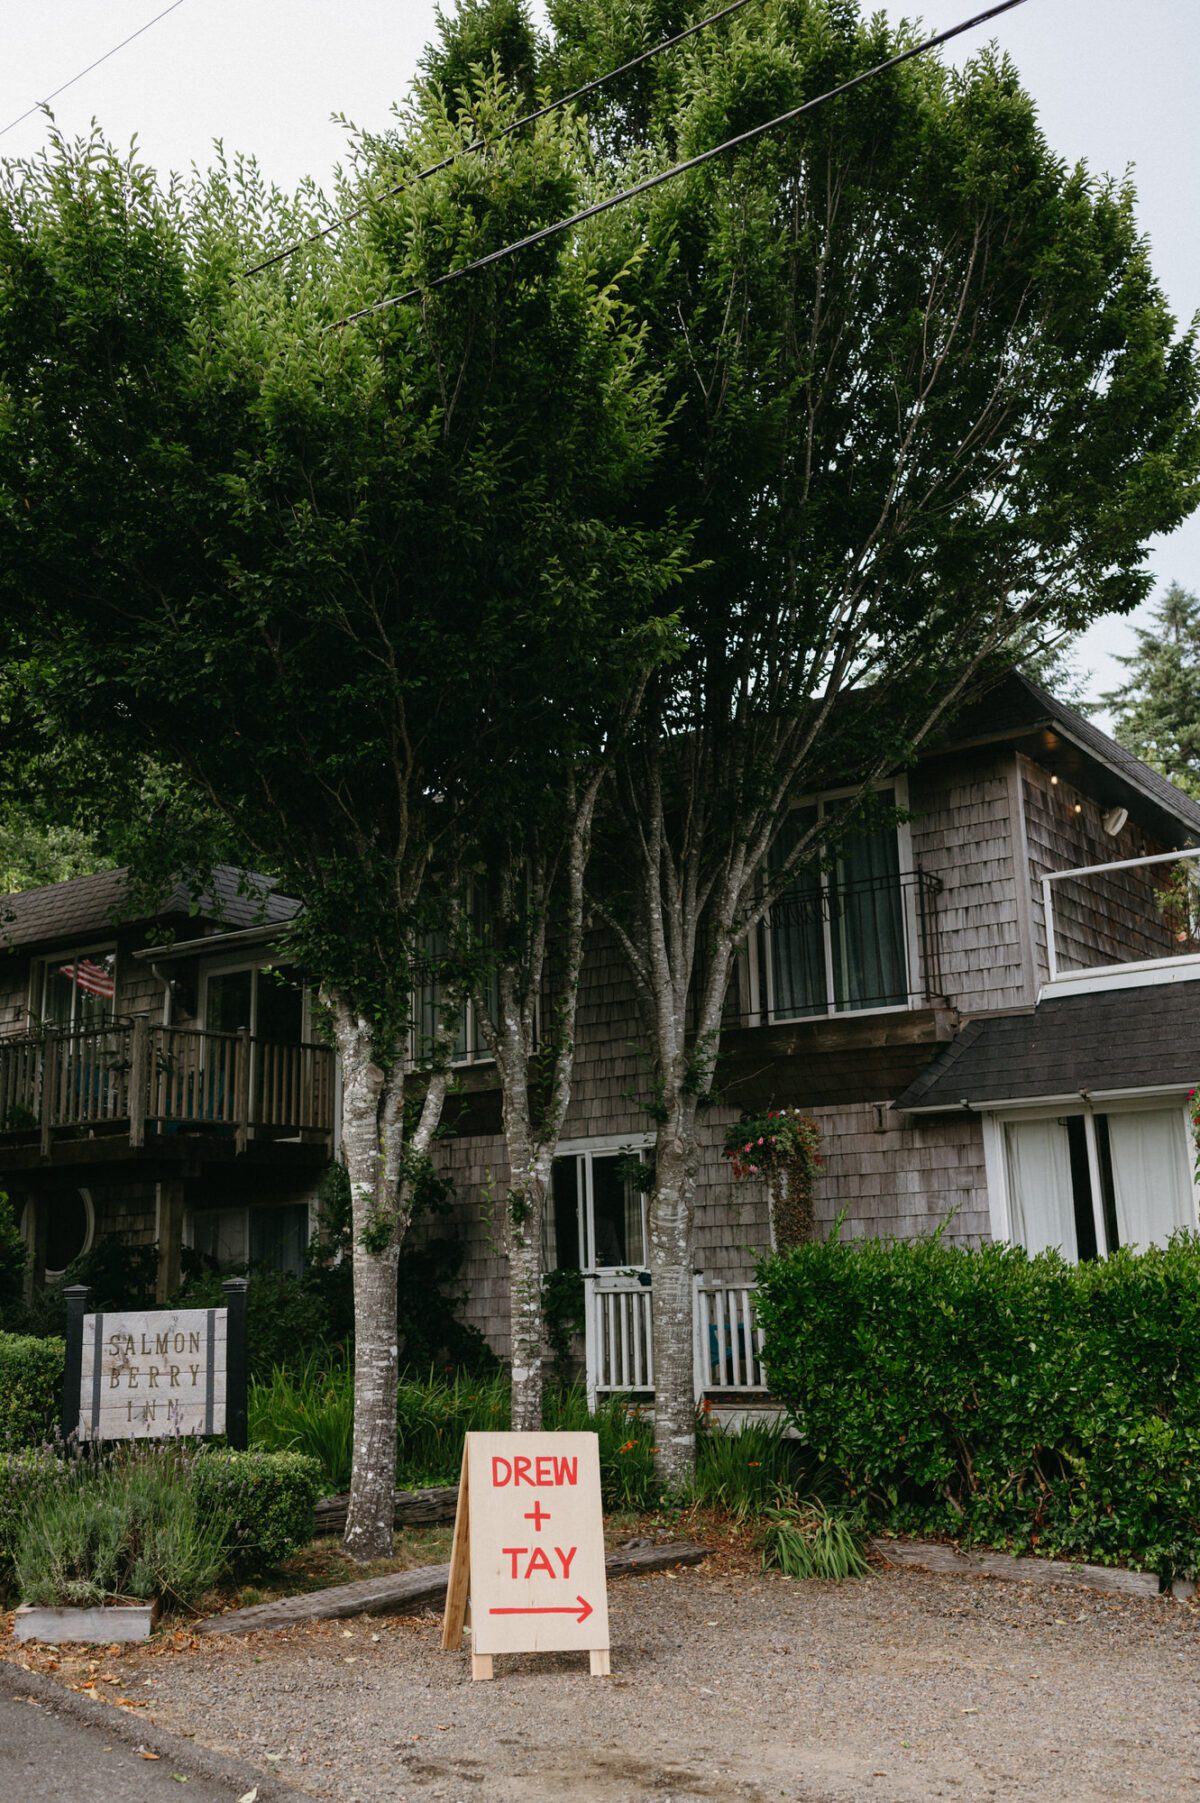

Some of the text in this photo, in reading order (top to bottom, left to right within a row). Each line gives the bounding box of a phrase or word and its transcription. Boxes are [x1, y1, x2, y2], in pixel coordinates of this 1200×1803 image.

[109, 1332, 200, 1355] SALMON
[110, 1364, 199, 1389] BERRY
[127, 1399, 179, 1422] INN
[491, 1456, 578, 1487] DREW
[524, 1500, 551, 1532] +
[502, 1546, 578, 1579] TAY
